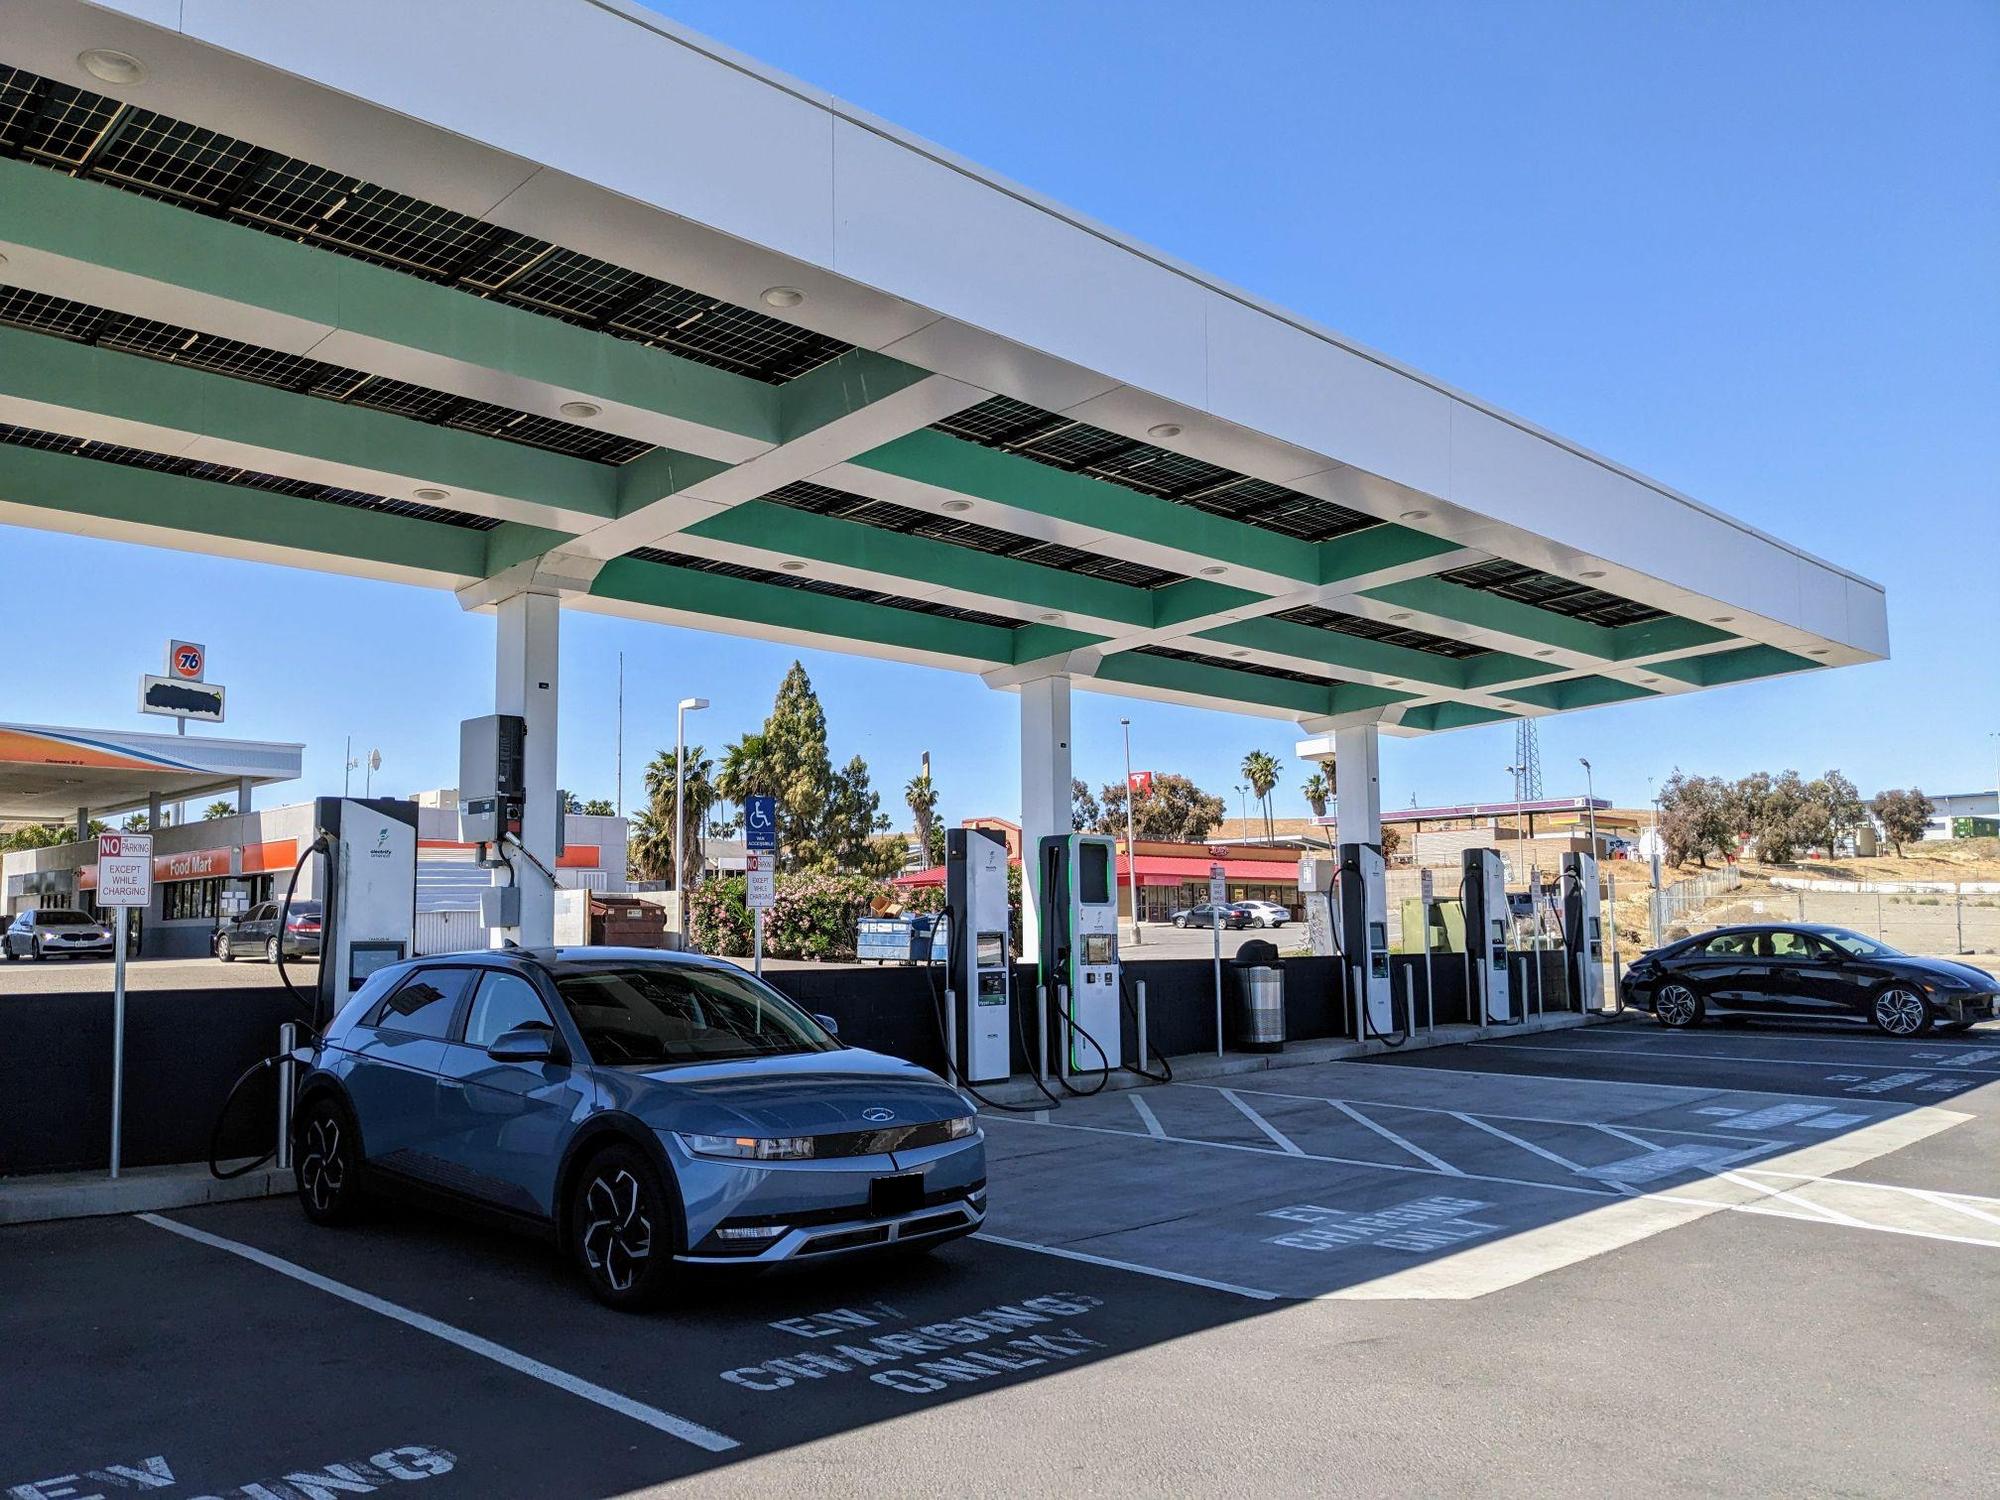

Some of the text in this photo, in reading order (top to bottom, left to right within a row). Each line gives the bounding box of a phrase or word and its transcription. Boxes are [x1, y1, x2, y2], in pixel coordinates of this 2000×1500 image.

[178, 652, 200, 670] 76
[101, 838, 150, 854] NO PARKING
[109, 864, 142, 874] EXCEPT
[170, 856, 213, 876] Food Mart
[748, 857, 758, 870] NO
[112, 876, 138, 885] WHILE
[102, 887, 146, 896] CHARGING
[1267, 1204, 1347, 1223] EV
[1272, 1196, 1485, 1251] CHARGING
[1373, 1217, 1499, 1252] ONLY
[719, 1292, 1104, 1392] CHARGING
[869, 1327, 1108, 1394] ONLY
